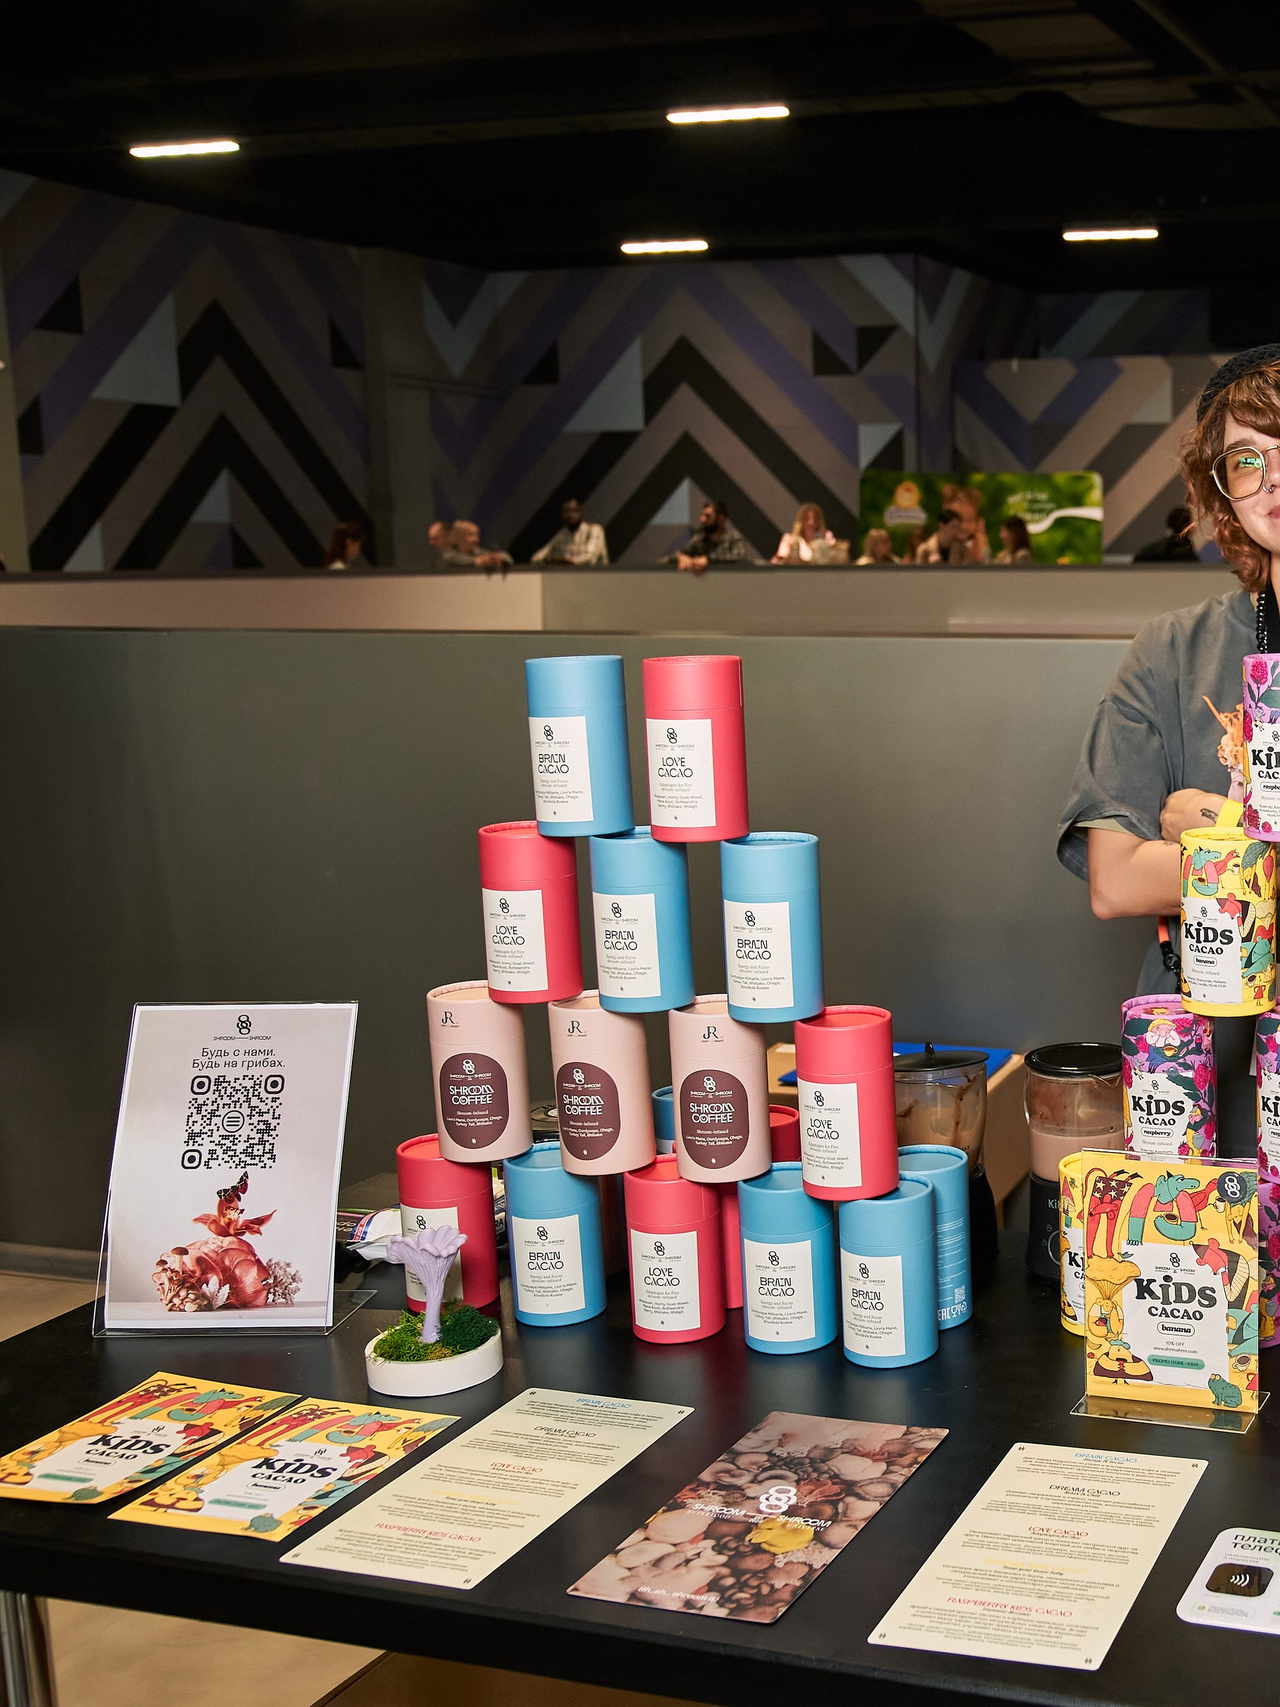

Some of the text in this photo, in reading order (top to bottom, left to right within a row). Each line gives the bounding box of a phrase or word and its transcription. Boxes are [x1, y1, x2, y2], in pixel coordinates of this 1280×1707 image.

[538, 753, 566, 763] BRAIN
[662, 757, 685, 767] LOVE
[538, 764, 569, 774] CACAO
[658, 768, 693, 778] CACAO
[496, 925, 518, 935] LOVE
[605, 930, 634, 940] BRAIN
[492, 935, 525, 945] CACAO
[604, 940, 638, 951] CACAO
[737, 939, 768, 949] BRAIN
[736, 949, 771, 960] CACAO
[1189, 944, 1224, 955] CACAO
[201, 1047, 276, 1060] Будь с нами.
[192, 1058, 286, 1071] Будь на грибах.
[449, 1084, 494, 1096] SHROOM
[451, 1094, 493, 1105] COFFEE
[562, 1094, 604, 1106] SHROOM
[565, 1105, 603, 1116] COFFEE
[689, 1102, 735, 1114] SHROOM
[691, 1113, 733, 1123] COFFEE
[810, 1118, 832, 1129] LOVE
[1138, 1116, 1176, 1126] CACAO
[807, 1128, 839, 1140] CACAO
[529, 1251, 560, 1261] BRAIN
[527, 1261, 564, 1271] CACAO
[648, 1267, 673, 1276] LOVE
[644, 1276, 680, 1286] CACAO
[760, 1276, 791, 1287] BRAIN
[758, 1286, 795, 1297] CACAO
[851, 1288, 881, 1300] BRAIN
[850, 1298, 884, 1311] CACAO
[1148, 1306, 1203, 1320] CACAO
[1161, 1324, 1191, 1333] banana
[85, 1449, 138, 1460] CACAO
[251, 1472, 307, 1484] CACAO
[1049, 1484, 1121, 1496] DREAM CACAO
[692, 1503, 832, 1528] SHROOM SHROOM
[1028, 1525, 1089, 1537] LOVE CACAO
[946, 1596, 1009, 1609] RASPBERRY
[1035, 1608, 1073, 1617] CACAO
